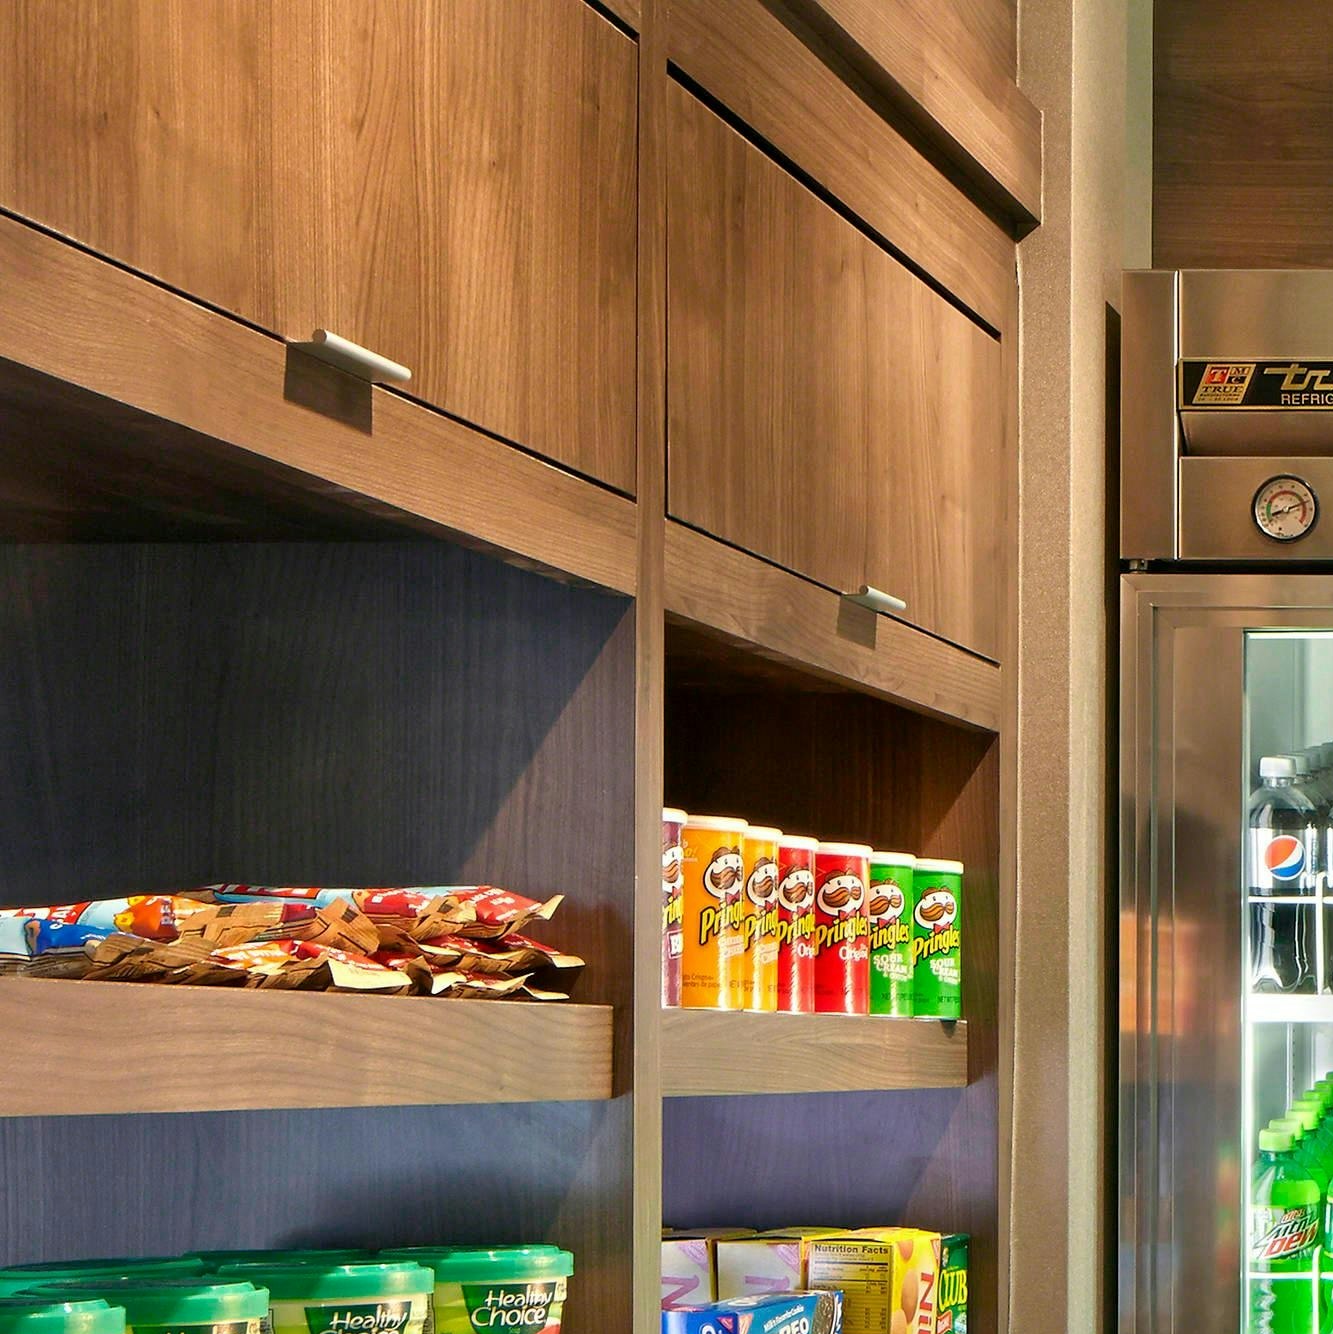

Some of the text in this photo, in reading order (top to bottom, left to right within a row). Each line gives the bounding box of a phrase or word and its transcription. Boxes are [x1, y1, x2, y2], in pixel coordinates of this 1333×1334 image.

[815, 910, 868, 956] Pringles
[913, 924, 960, 966] Pringles
[815, 1244, 889, 1254] Nutrition Facts
[485, 1284, 553, 1307] Healthy
[940, 1269, 968, 1313] CLUB
[329, 1305, 407, 1330] Healthy
[471, 1305, 546, 1327] Choice
